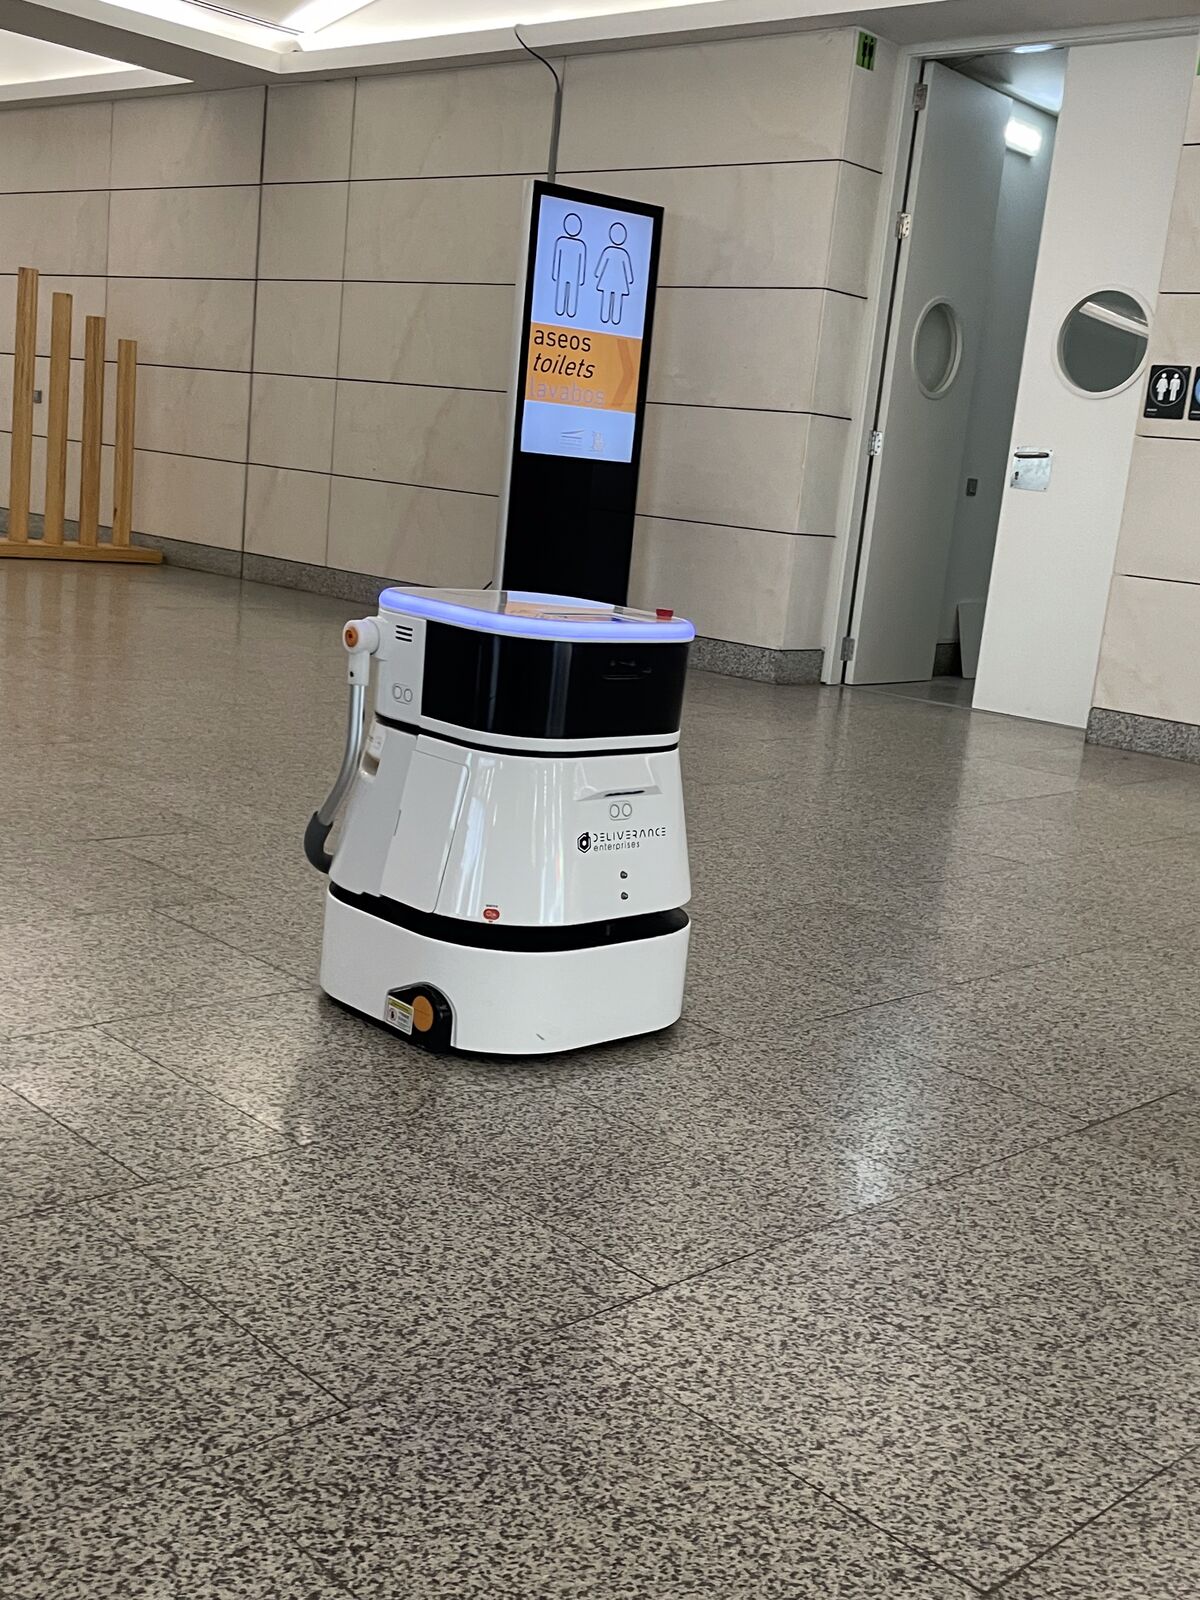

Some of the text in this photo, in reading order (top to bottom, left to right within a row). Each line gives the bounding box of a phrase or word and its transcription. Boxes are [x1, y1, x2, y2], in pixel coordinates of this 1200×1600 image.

[533, 329, 592, 352] aseos
[533, 352, 595, 378] toilets
[530, 375, 605, 405] lavabos
[593, 827, 666, 842] DELIVERANCE
[593, 841, 640, 852] enterprises
